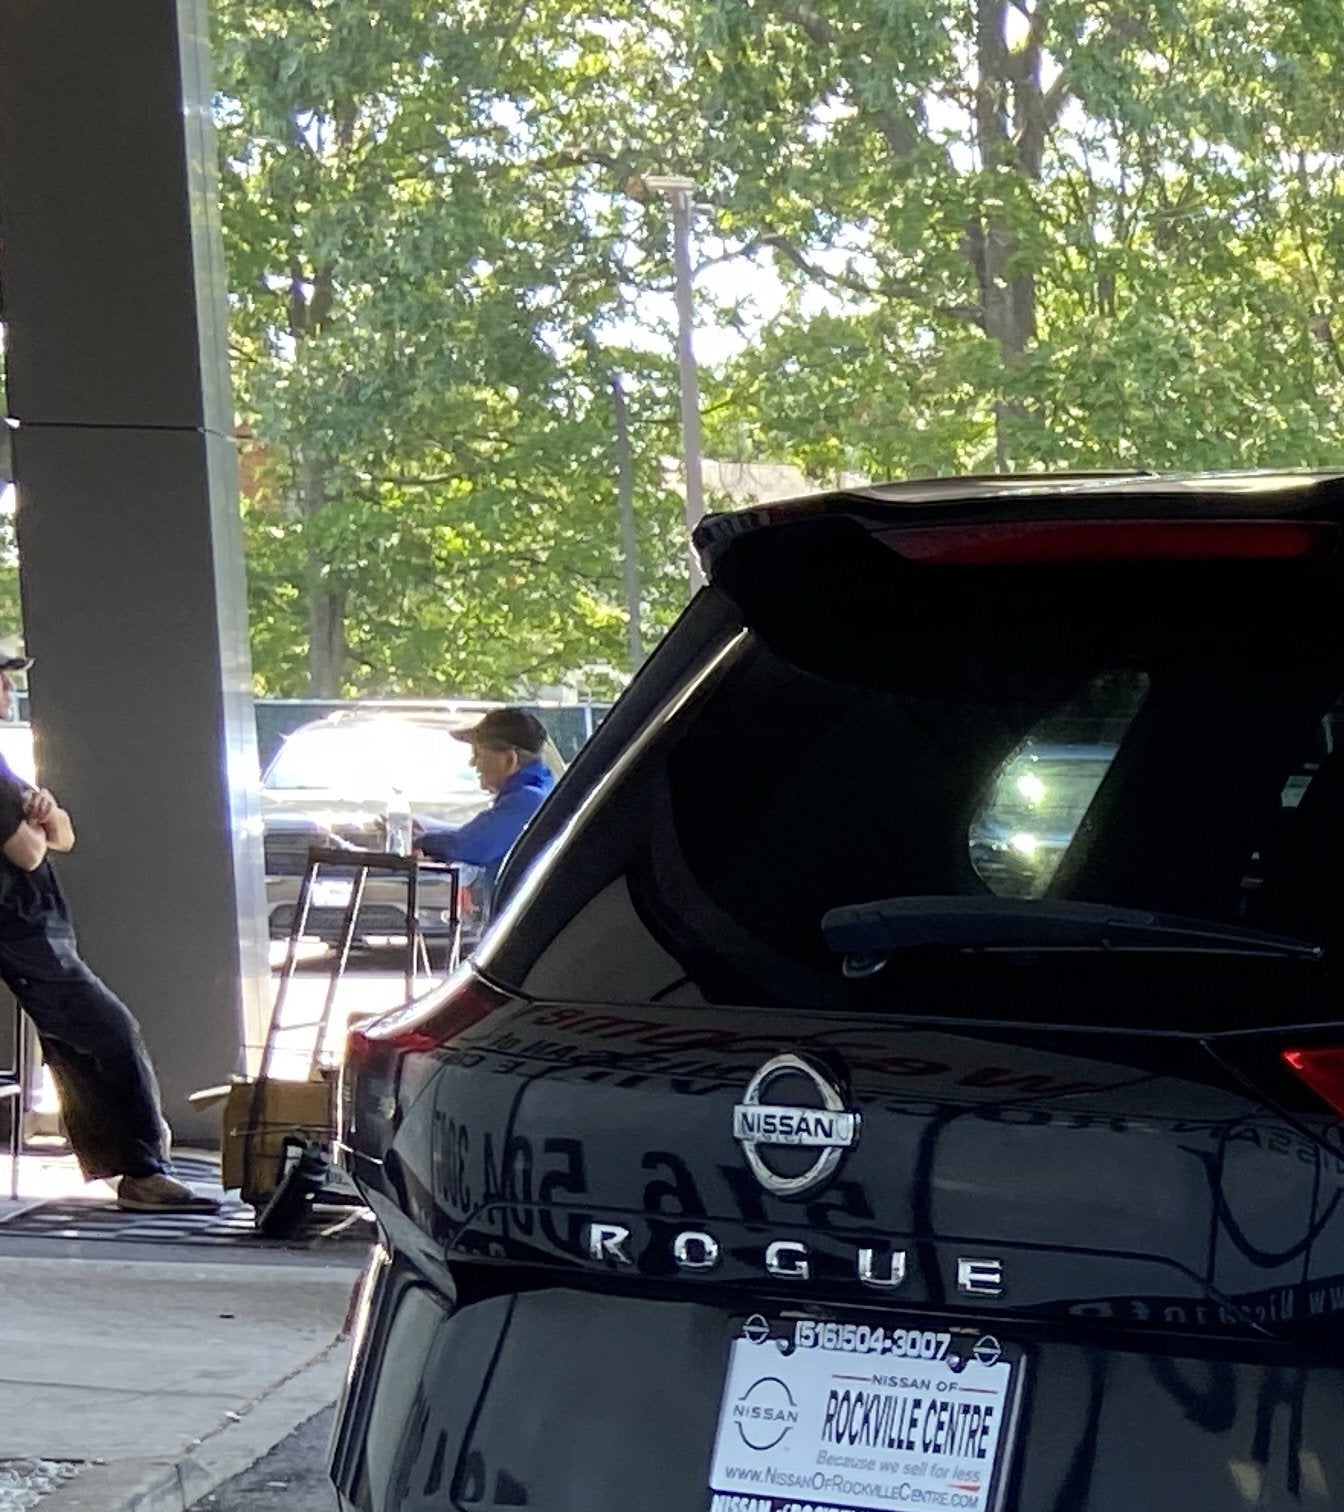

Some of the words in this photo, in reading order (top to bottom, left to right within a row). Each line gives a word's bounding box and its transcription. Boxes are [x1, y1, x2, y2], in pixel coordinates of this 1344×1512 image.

[741, 1111, 834, 1139] NISSAN
[588, 1222, 1003, 1296] ROGUE
[872, 1374, 932, 1391] NISSAN
[936, 1380, 960, 1393] OF
[733, 1404, 799, 1423] NISSAN
[821, 1390, 922, 1451] ROCKVILLE
[922, 1398, 993, 1459] CENTRE
[816, 1449, 876, 1472] Because
[879, 1461, 900, 1474] we
[903, 1461, 928, 1476] sell
[930, 1462, 950, 1479] for
[952, 1465, 981, 1483] less
